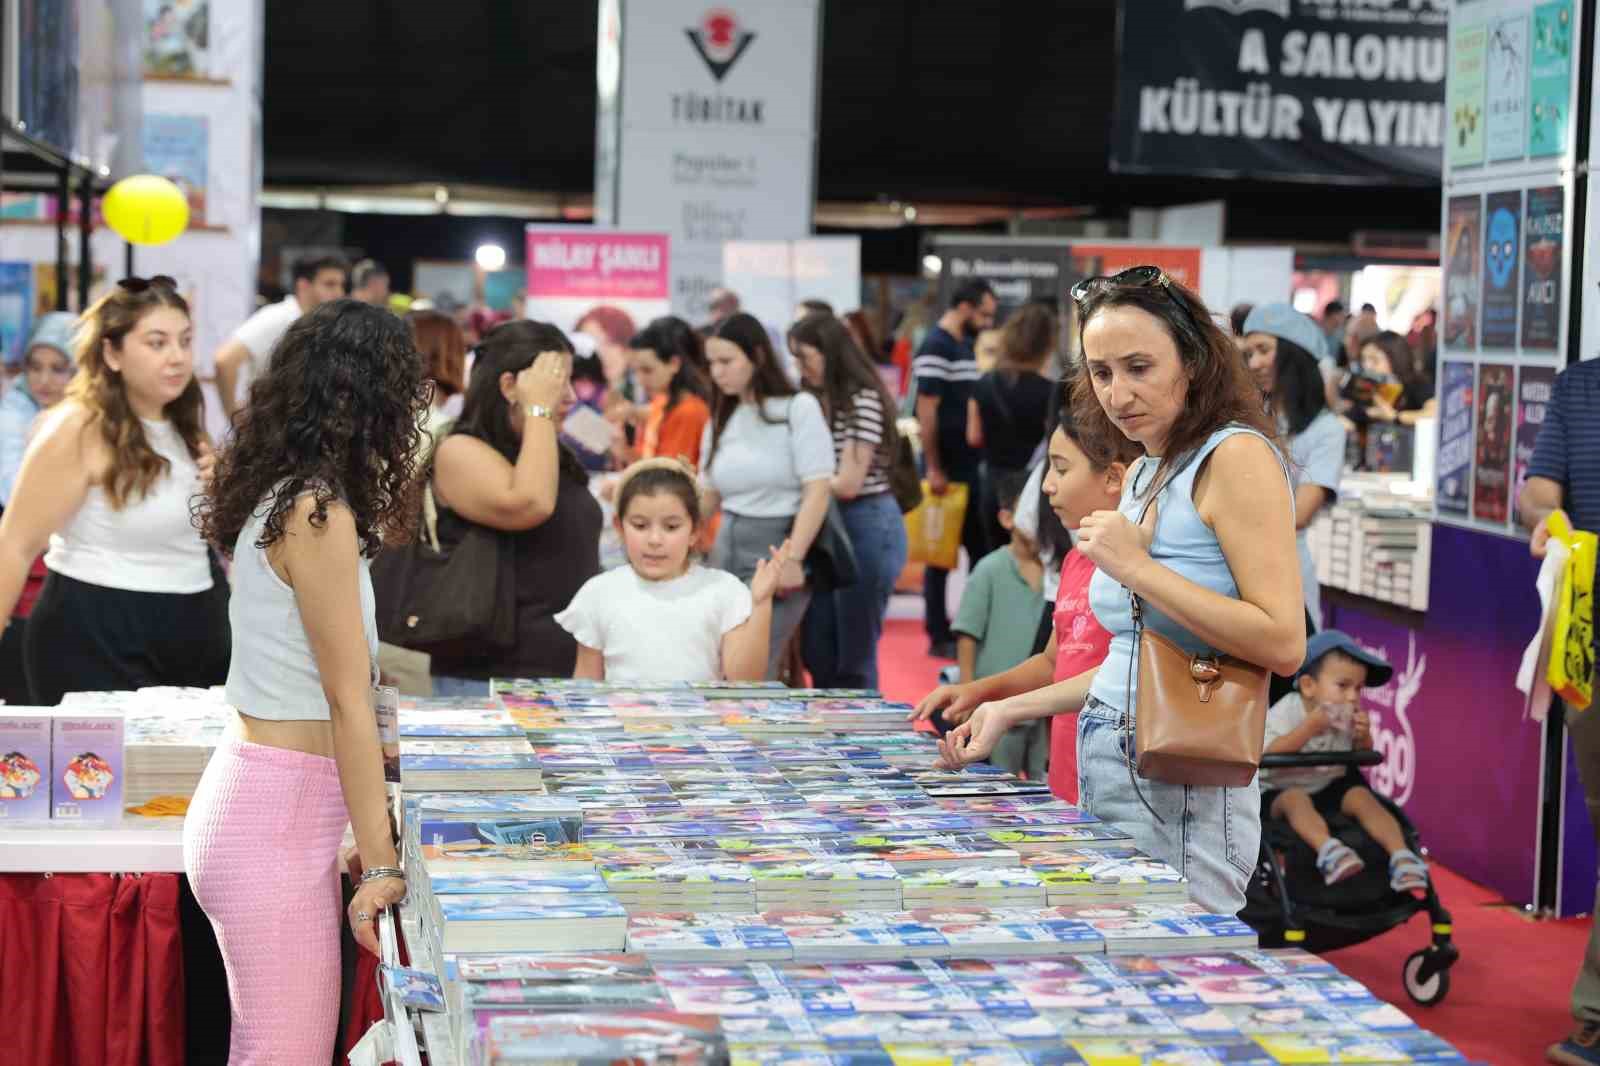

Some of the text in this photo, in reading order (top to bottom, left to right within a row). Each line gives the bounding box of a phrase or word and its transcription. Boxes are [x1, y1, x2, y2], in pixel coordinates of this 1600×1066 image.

[1238, 29, 1446, 83] A SALONU
[672, 93, 764, 123] TÜBİTAK
[1138, 78, 1303, 138] KÜLTÜR
